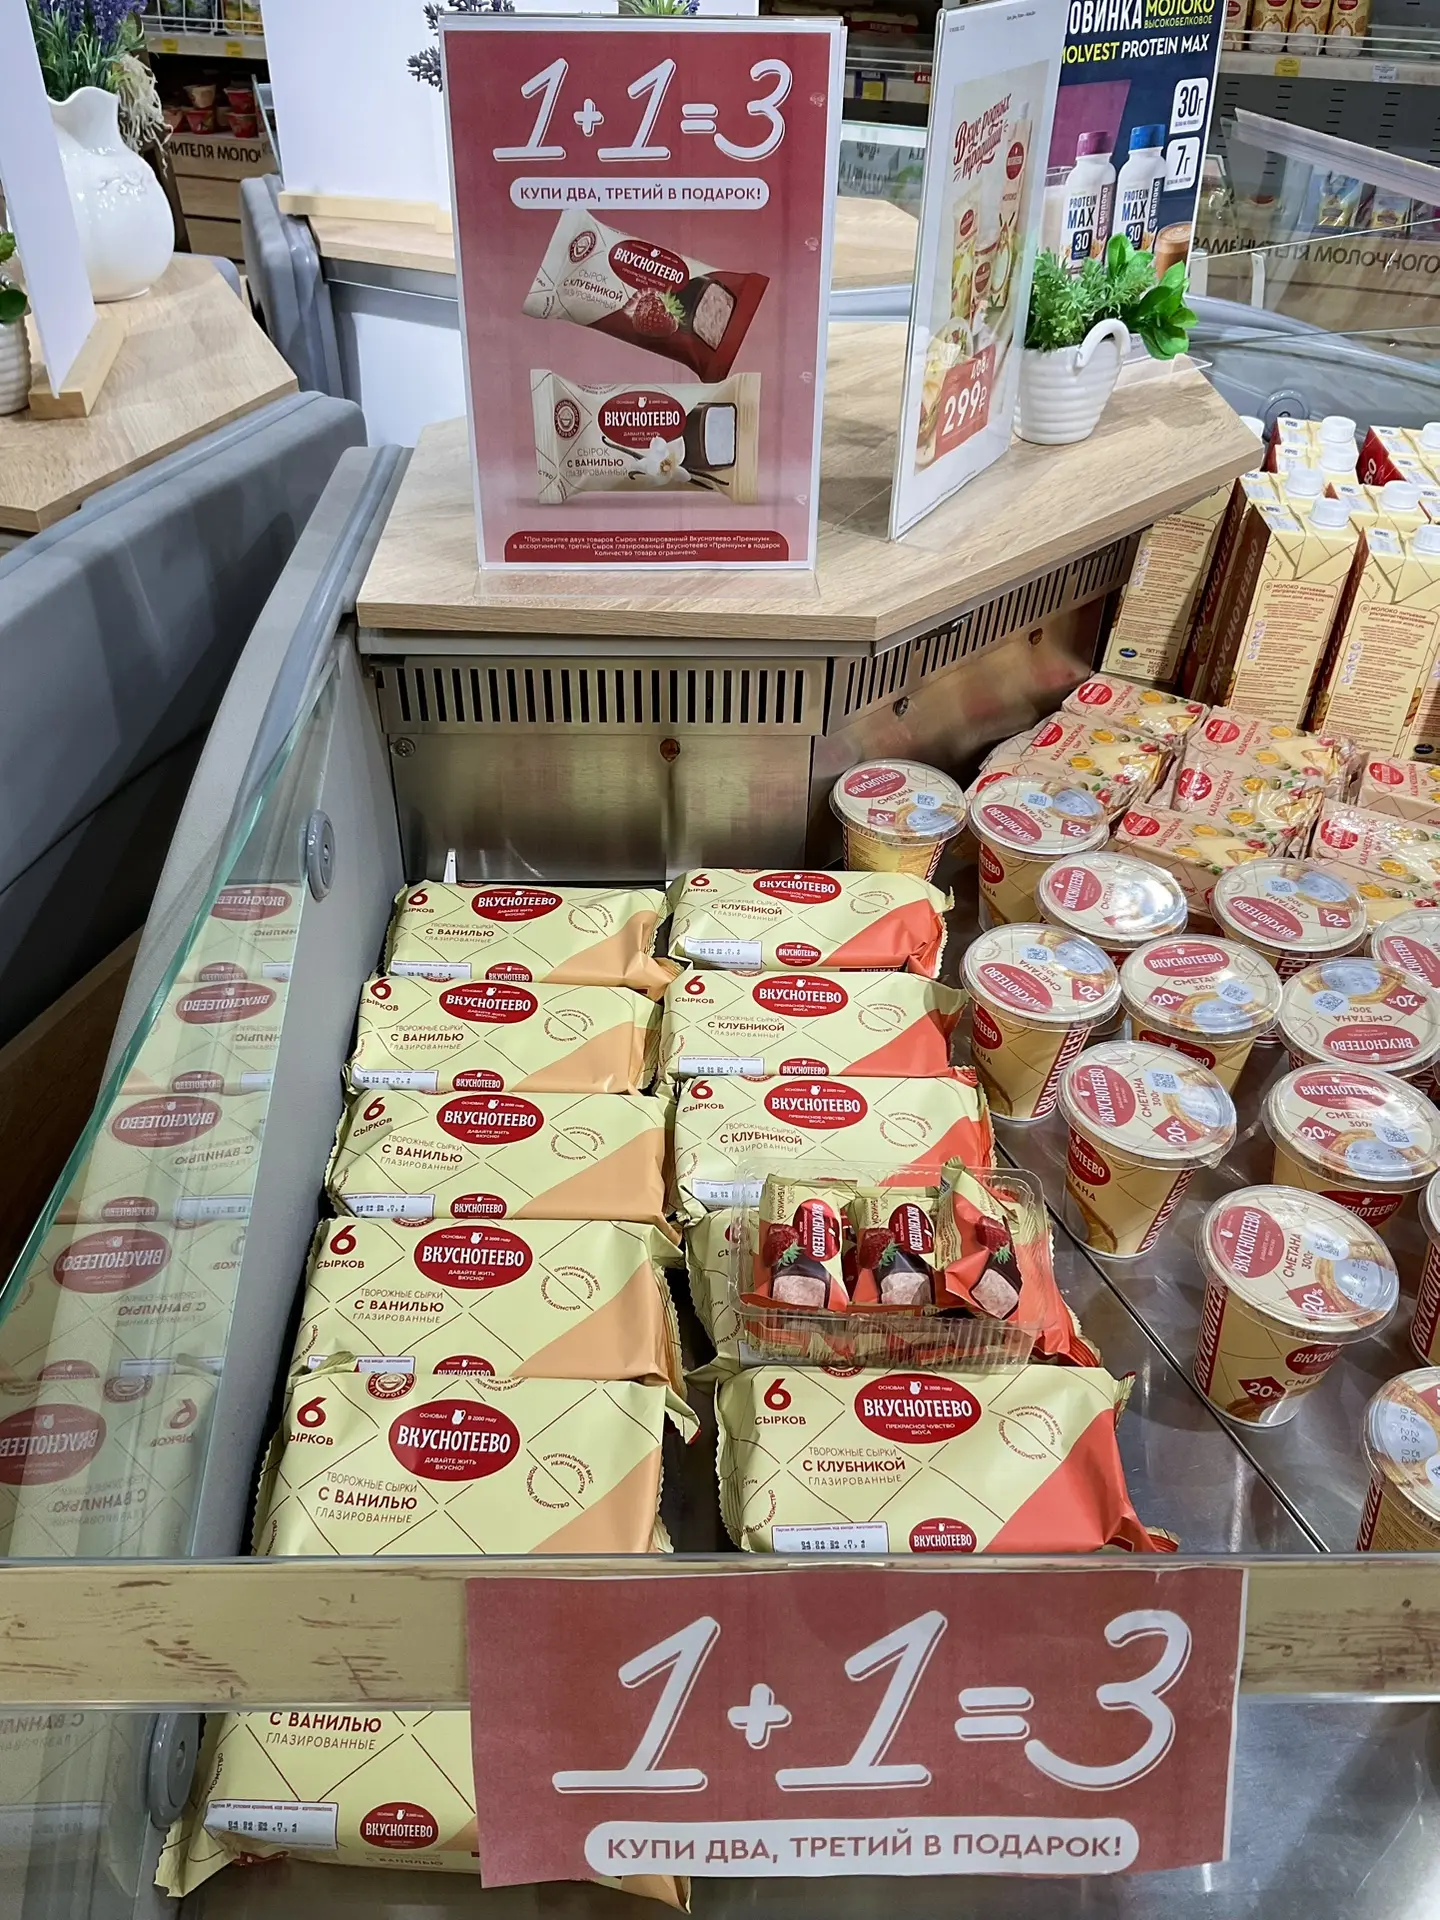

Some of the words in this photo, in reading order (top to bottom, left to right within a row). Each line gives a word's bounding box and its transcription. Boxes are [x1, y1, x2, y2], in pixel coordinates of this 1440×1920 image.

[1069, 0, 1142, 34] ОВИНКА
[1145, 0, 1214, 17] МОЛОКО
[1144, 15, 1212, 29] ВЫСОКОБЕЛКОВОЕ
[1121, 36, 1178, 59] PROTEIN
[1181, 34, 1210, 52] MAX
[493, 57, 793, 162] 1+1=3
[1178, 85, 1203, 118] 30г
[1176, 145, 1190, 176] 7г
[520, 186, 562, 200] КУПИ
[566, 186, 600, 202] ДВА,
[605, 184, 663, 200] ТРЕТИЙ
[668, 186, 676, 200] В
[682, 186, 760, 201] ПОДАРОК!
[1123, 189, 1149, 201] PROTEIN
[1069, 195, 1097, 208] PROTEIN
[1068, 208, 1096, 229] MAX
[1121, 200, 1147, 222] MAX
[1075, 232, 1089, 250] 30
[1128, 225, 1141, 241] 30
[614, 247, 684, 284] ВКУСНОТЕЕВО
[578, 269, 608, 285] СЫРОК
[570, 279, 623, 302] КЛУБНИКОЙ
[605, 410, 680, 427] ВКУСНОТЕЕВО
[577, 448, 610, 457] СЫРОК
[567, 459, 573, 467] С
[575, 458, 624, 467] ВАНИЛЬЮ
[408, 888, 429, 906] 6
[477, 897, 556, 908] ВКУСНОТЕЕВО
[721, 902, 783, 916] КЛУБНИКОЙ
[437, 928, 495, 937] ВАНИЛЬЮ
[1019, 959, 1061, 992] СМЕТАНА
[684, 975, 705, 995] 6
[445, 994, 531, 1011] ВКУСНОТЕЕВО
[675, 996, 714, 1004] СЫРКОВ
[759, 988, 842, 1003] ВКУСНОТЕЕВО
[1152, 993, 1183, 1006] 20%
[1386, 993, 1419, 1007] 20%
[1348, 1005, 1373, 1013] 300г
[718, 1021, 785, 1031] КЛУБНИКОЙ
[1332, 1014, 1392, 1023] СМЕТАНА
[403, 1033, 464, 1042] ВАНИЛЬЮ
[691, 1079, 713, 1100] 6
[1134, 1077, 1152, 1118] СМЕТАНА
[363, 1096, 386, 1121] 6
[682, 1102, 725, 1113] СЫРКОВ
[771, 1097, 861, 1113] ВКУСНОТЕЕВО
[443, 1110, 537, 1128] ВКУСНОТЕЕВО
[353, 1117, 393, 1138] СЫРКОВ
[1301, 1126, 1335, 1140] 20%
[388, 1134, 434, 1150] ТВОРОЖНЫЕ
[731, 1132, 803, 1146] КЛУБНИКОЙ
[382, 1144, 391, 1154] С
[396, 1145, 463, 1163] ВАНИЛЬЮ
[380, 1156, 460, 1172] ГЛАЗИРОВАННЫЕ
[330, 1224, 357, 1256] 6
[422, 1245, 524, 1267] ВКУСНОТЕЕВО
[1283, 1233, 1302, 1278] СМЕТАНА
[1301, 1250, 1314, 1270] 300г
[316, 1259, 366, 1270] СЫРКОВ
[360, 1288, 414, 1299] ТВОРОЖНЫЕ
[416, 1290, 444, 1299] СЫРКИ
[354, 1300, 365, 1310] С
[369, 1300, 444, 1312] ВАНИЛЬЮ
[352, 1312, 441, 1324] ГЛАЗИРОВАННЫЕ
[764, 1378, 792, 1411] 6
[1247, 1382, 1282, 1398] 20%
[296, 1396, 326, 1429] 6
[863, 1397, 973, 1420] ВКУСНОТЕЕВО
[754, 1415, 807, 1427] СЫРКОВ
[927, 1422, 956, 1430] ЧУВСТВО
[397, 1427, 512, 1453] ВКУСНОТЕЕВО
[808, 1446, 863, 1457] ТВОРОЖНЫЕ
[865, 1446, 897, 1457] СЫРКИ
[424, 1457, 456, 1465] ДАВАЙТЕ
[550, 1460, 576, 1470] НЕЖНАЯ
[802, 1461, 813, 1473] С
[817, 1458, 906, 1473] КЛУБНИКОЙ
[326, 1472, 383, 1491] ТВОРОЖНЫЕ
[384, 1480, 418, 1493] СЫРКИ
[808, 1474, 902, 1487] ГЛАЗИРОВАННЫЕ
[318, 1487, 330, 1502] С
[334, 1490, 418, 1511] ВАНИЛЬЮ
[532, 1496, 570, 1509] ЛАКОМСТВО
[315, 1507, 412, 1524] ГЛАЗИРОВАННЫЕ
[552, 1610, 1191, 1794] 1+1=3
[265, 1732, 377, 1751] ГЛАЗИРОВАННЫЕ
[606, 1835, 696, 1862] КУПИ
[704, 1836, 778, 1866] ДВА,
[789, 1828, 912, 1859] ТРЕТИЙ
[924, 1834, 942, 1857] В
[952, 1832, 1121, 1860] ПОДАРОК!
